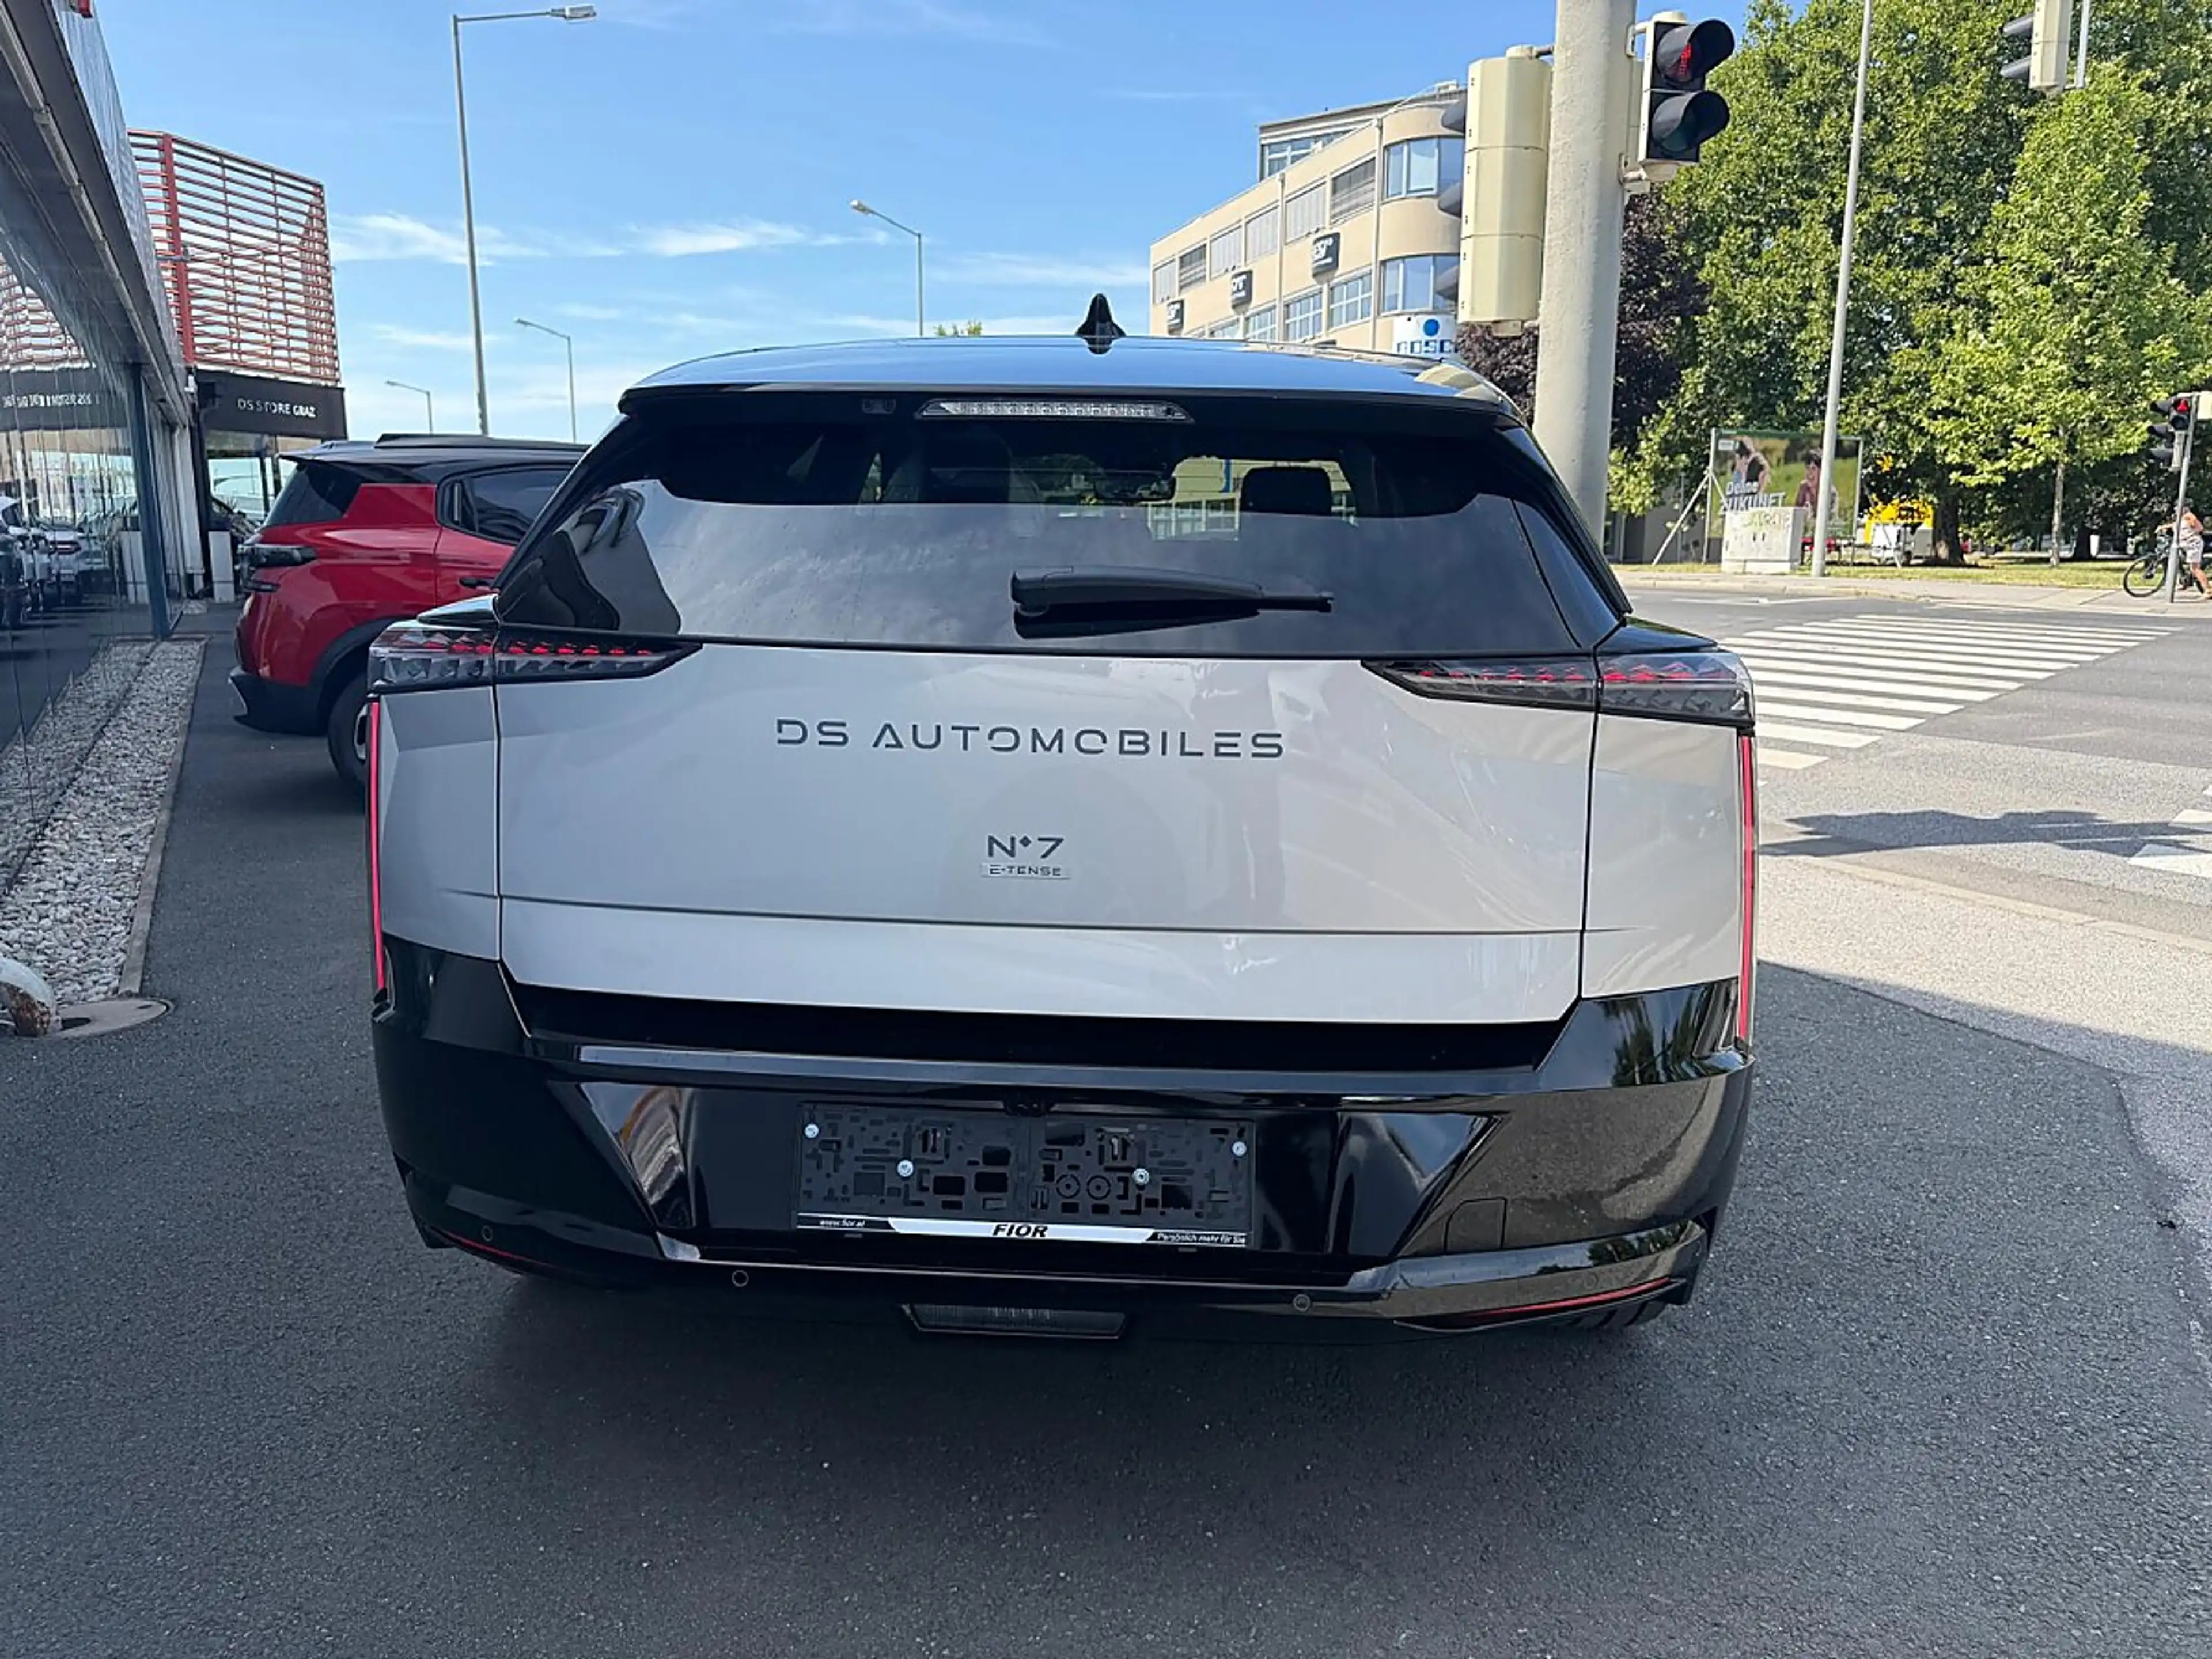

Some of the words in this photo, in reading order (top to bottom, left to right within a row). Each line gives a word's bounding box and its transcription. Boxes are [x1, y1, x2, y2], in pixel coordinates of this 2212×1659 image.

[237, 398, 253, 410] DS
[256, 400, 291, 414] STORE
[777, 719, 849, 746] DS
[872, 722, 1283, 759] AUTOMOBILES
[989, 864, 1061, 876] E-TENSE
[992, 1223, 1048, 1238] FIOR
